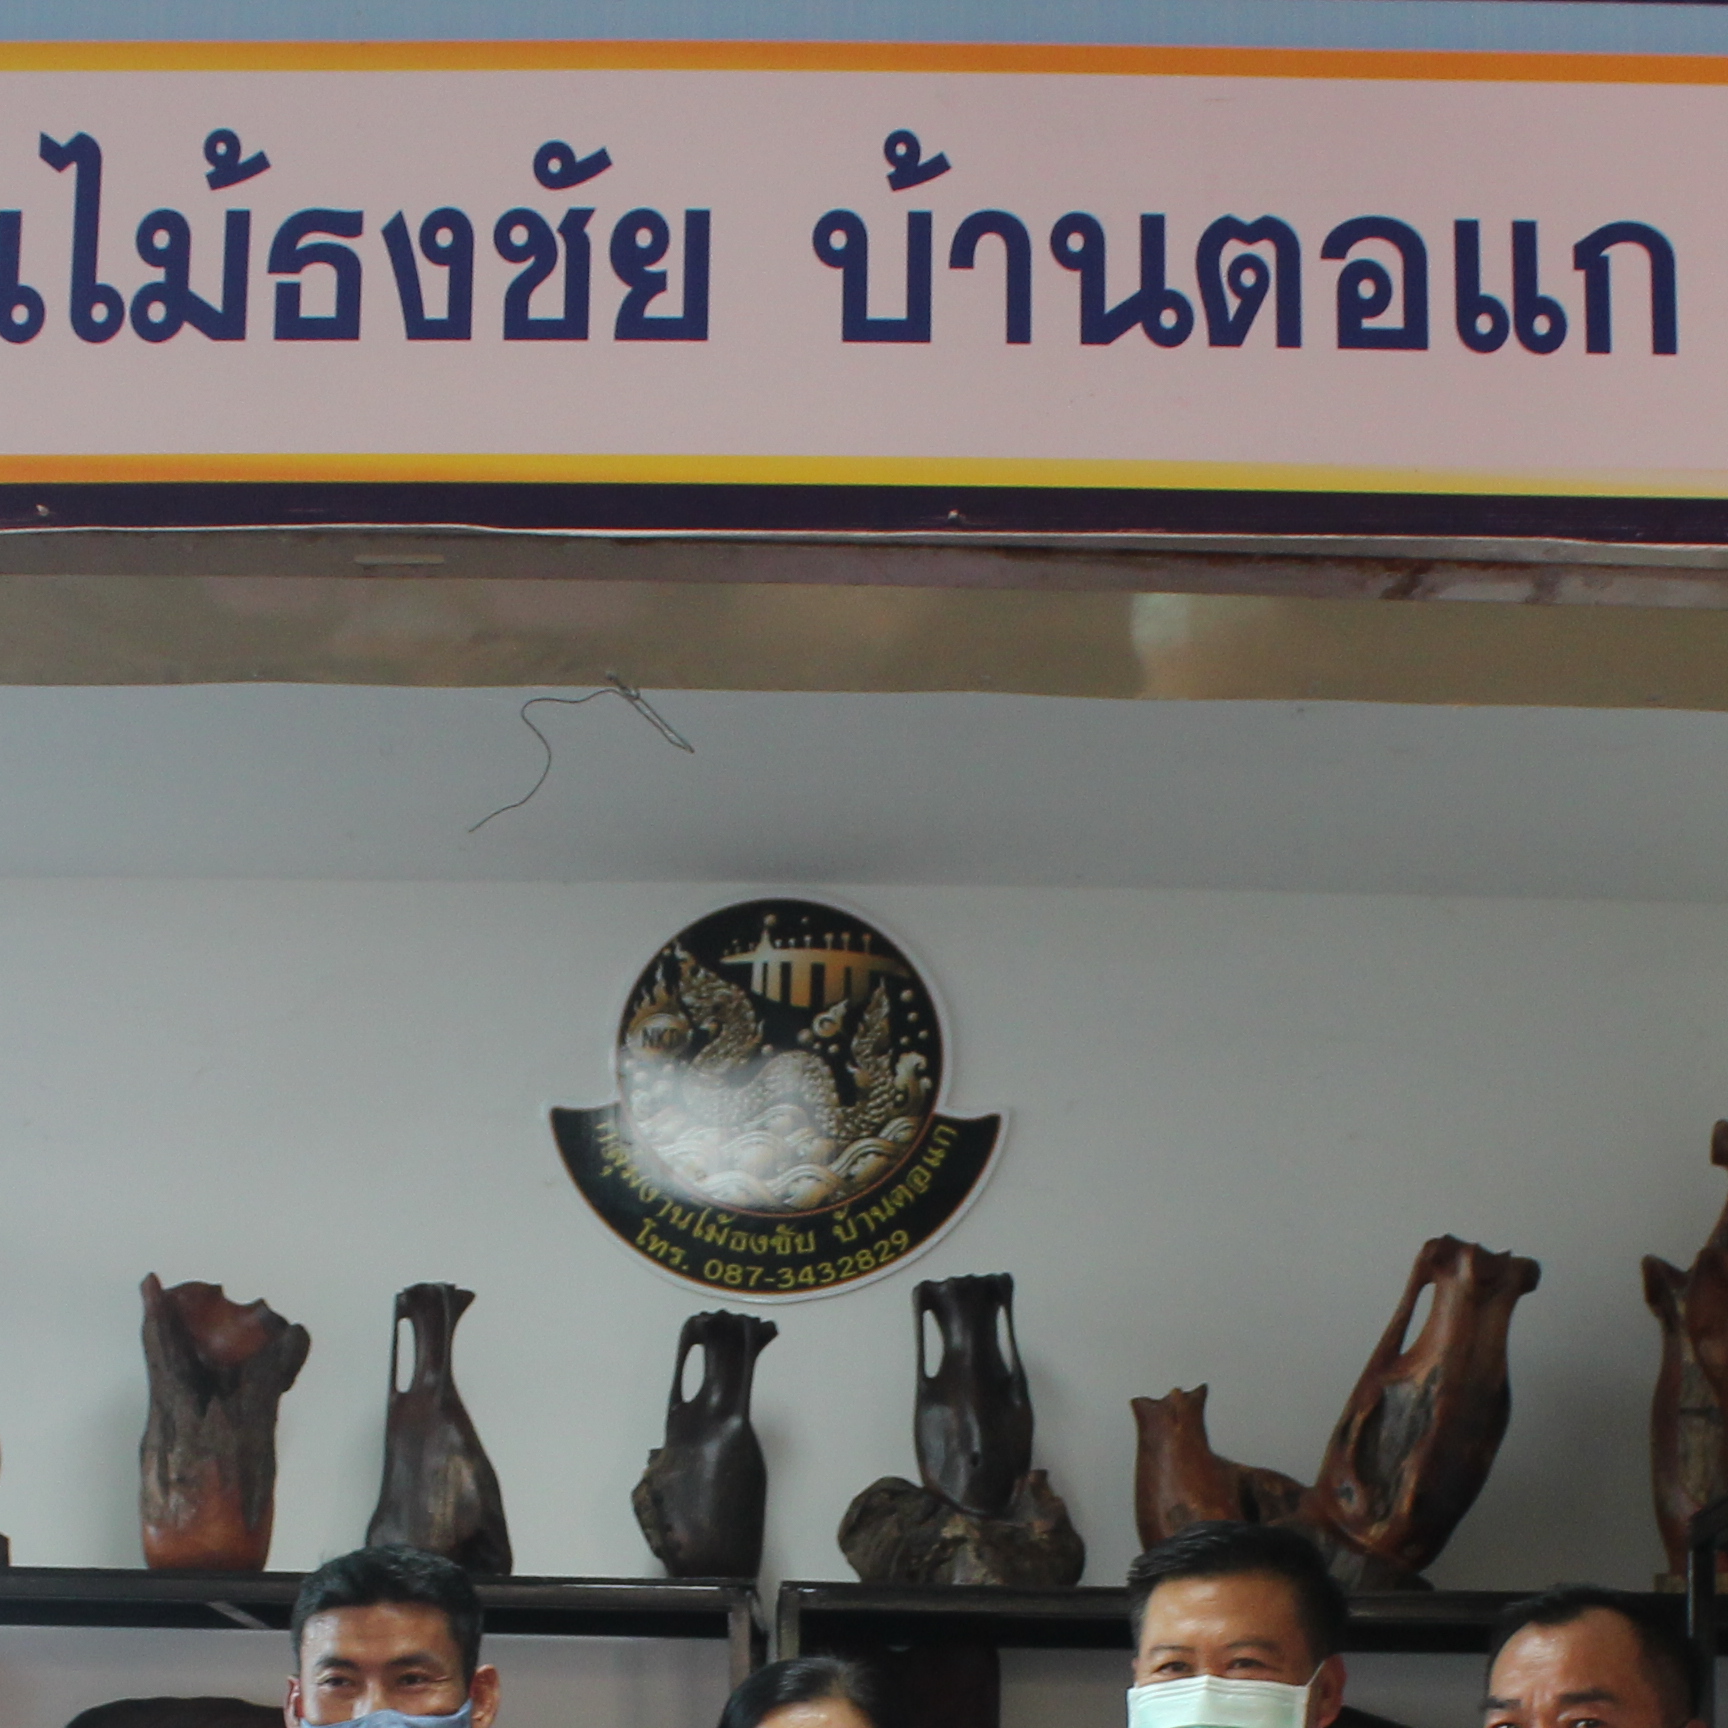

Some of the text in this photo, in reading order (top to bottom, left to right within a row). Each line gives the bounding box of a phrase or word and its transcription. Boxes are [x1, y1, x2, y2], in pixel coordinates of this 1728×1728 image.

[812, 130, 1679, 355] บ้านตอแก
[832, 1124, 958, 1243] บ้านตอแก
[634, 1217, 911, 1289] โทร. 087-3432829
